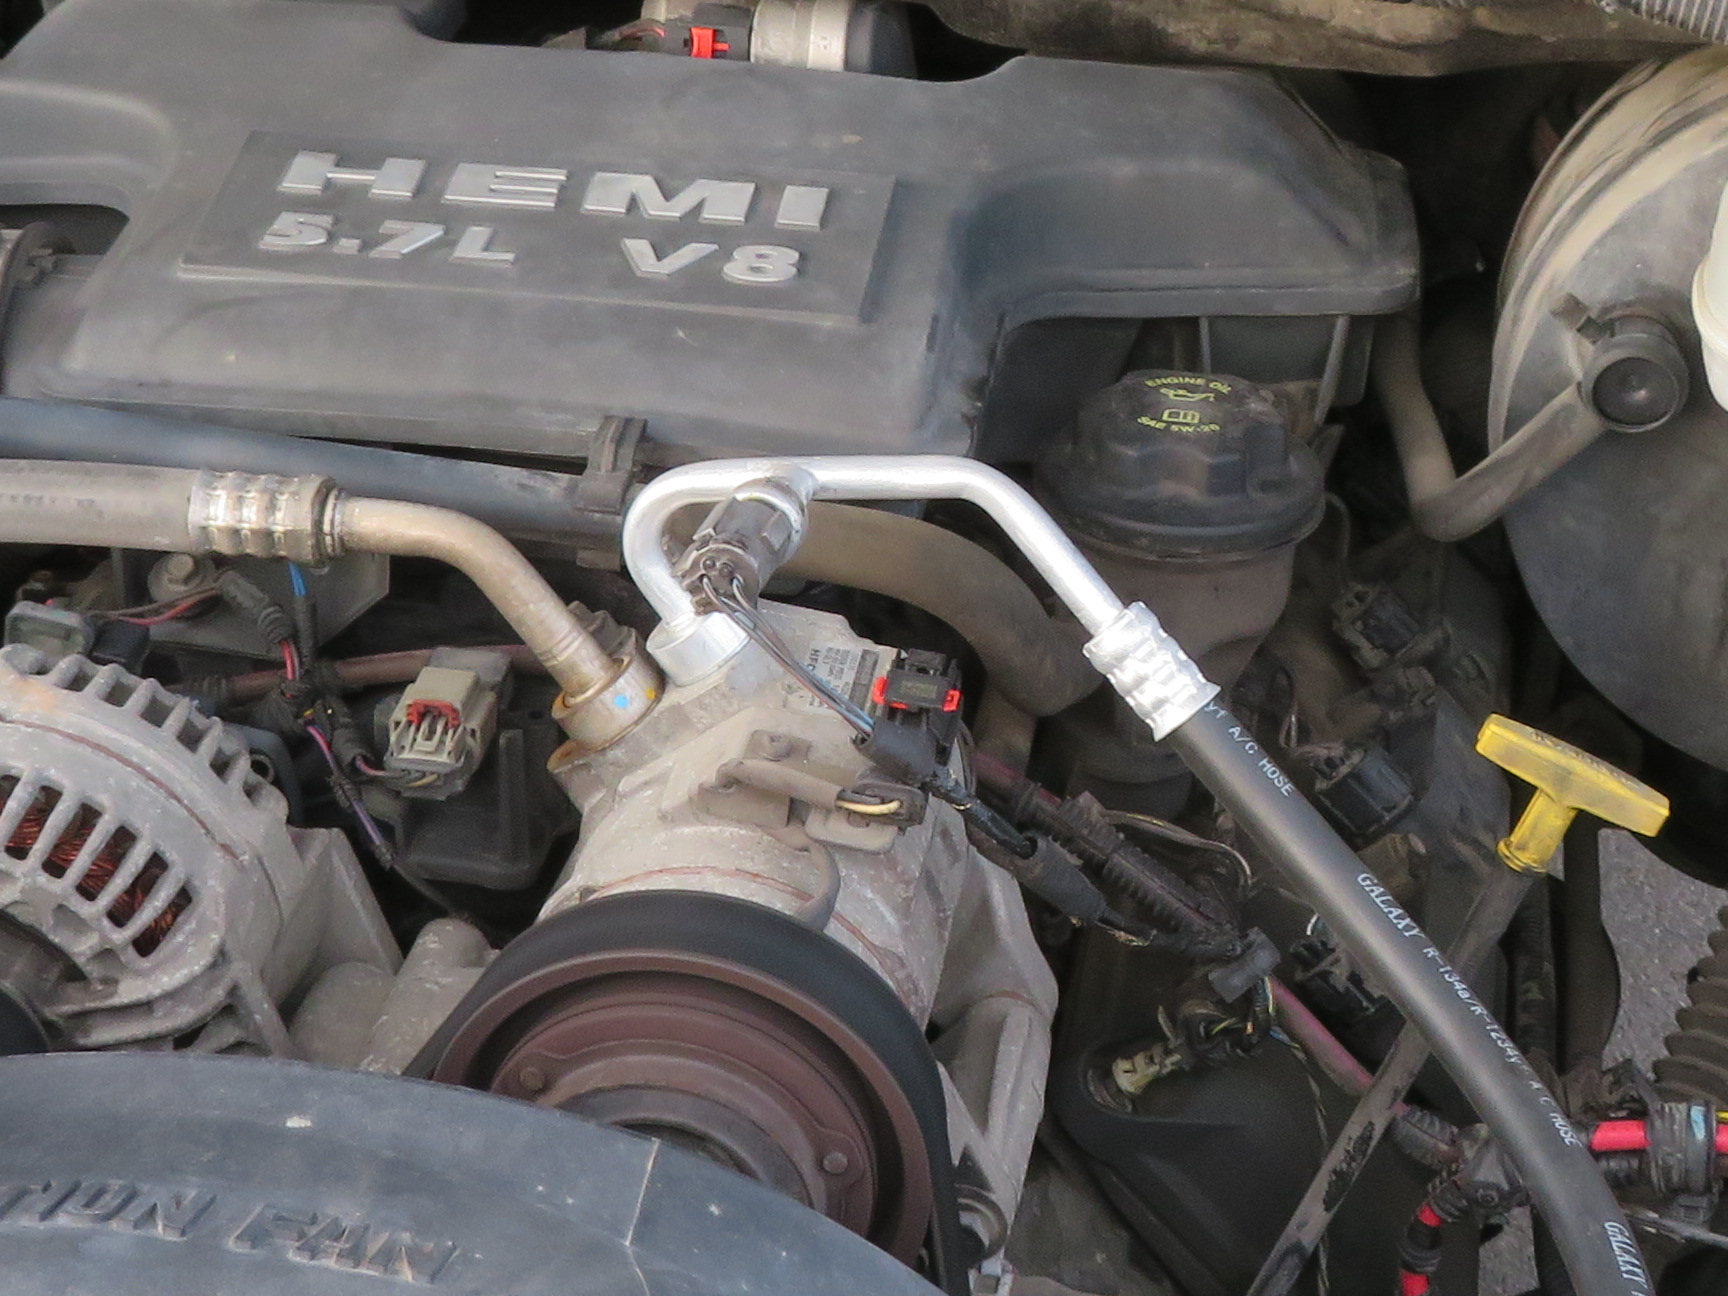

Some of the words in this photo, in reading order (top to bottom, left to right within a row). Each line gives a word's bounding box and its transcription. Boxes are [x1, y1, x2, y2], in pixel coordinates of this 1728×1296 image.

[277, 149, 829, 232] HEMI
[258, 210, 517, 268] 5.7L
[619, 237, 802, 285] V8
[1144, 376, 1206, 388] ENGINE
[1209, 381, 1232, 395] OIL
[1137, 416, 1167, 430] SAE
[1170, 423, 1221, 432] 5W-20
[1228, 726, 1258, 754] A/C
[1257, 757, 1297, 798] HOSE
[1357, 872, 1426, 939] GALAXY
[227, 1202, 460, 1288] FAN
[1603, 1220, 1647, 1291] GALAXY
